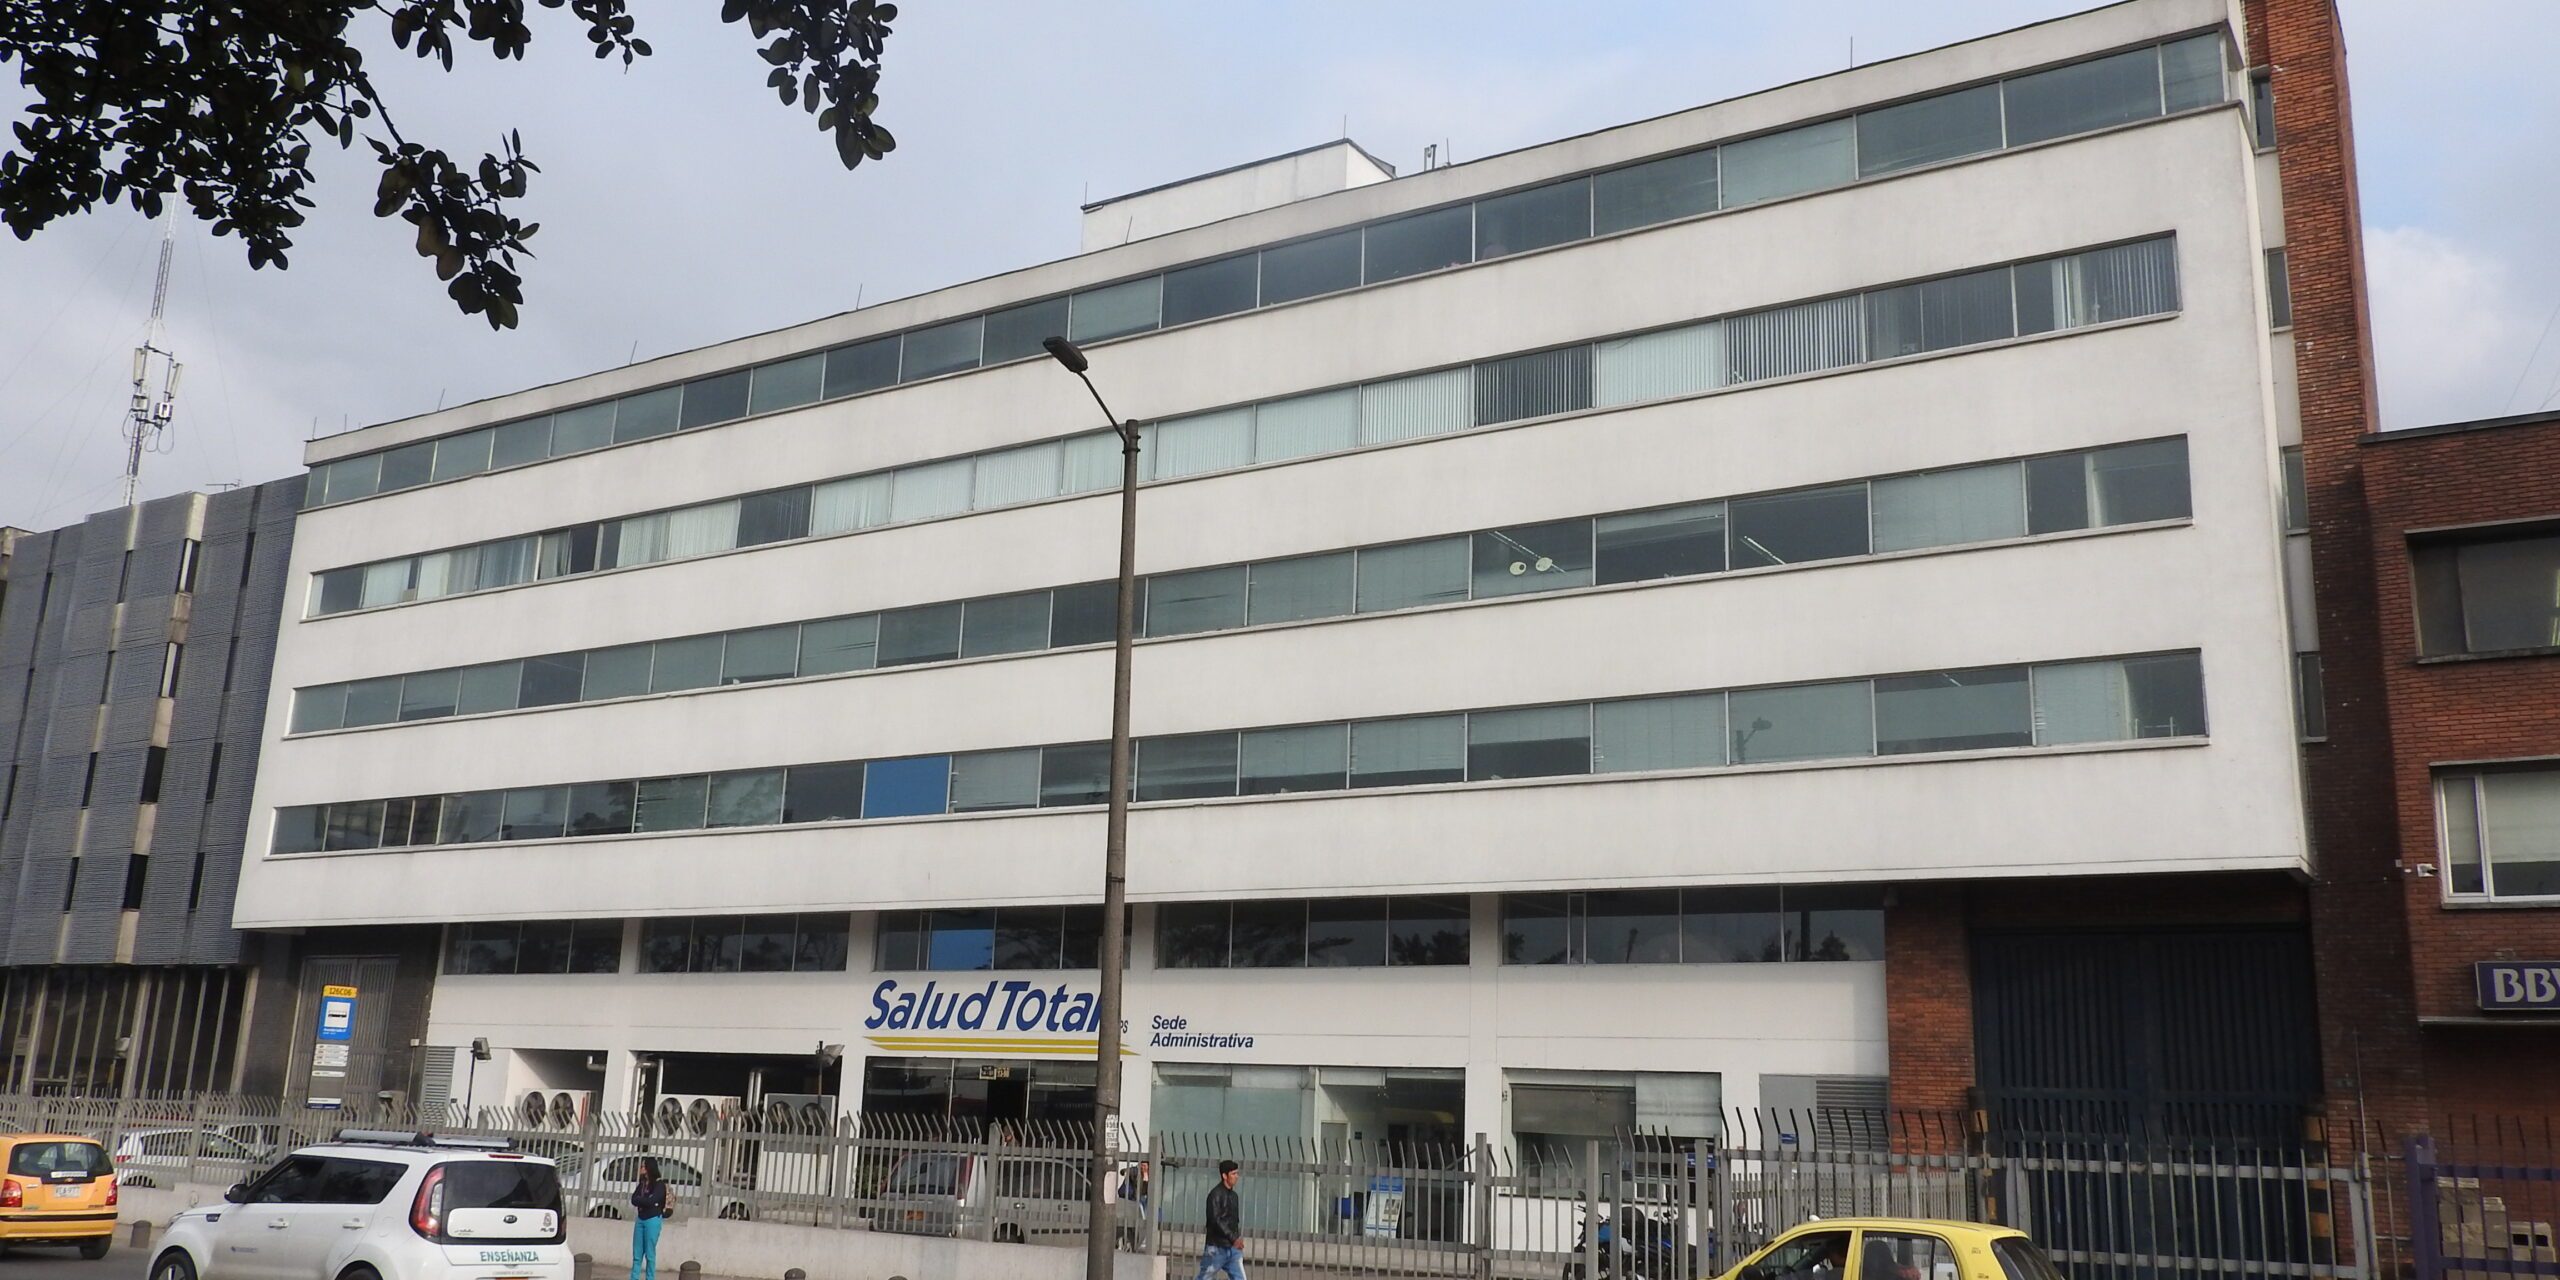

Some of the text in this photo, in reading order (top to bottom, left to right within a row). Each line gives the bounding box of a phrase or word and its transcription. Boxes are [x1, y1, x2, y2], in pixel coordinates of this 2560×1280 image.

[2493, 968, 2560, 1002] BB
[864, 979, 998, 1031] Salud
[1152, 1015, 1187, 1030] Sede
[1150, 1032, 1254, 1048] Administrativa
[480, 1249, 540, 1262] ENSEÑANZA
